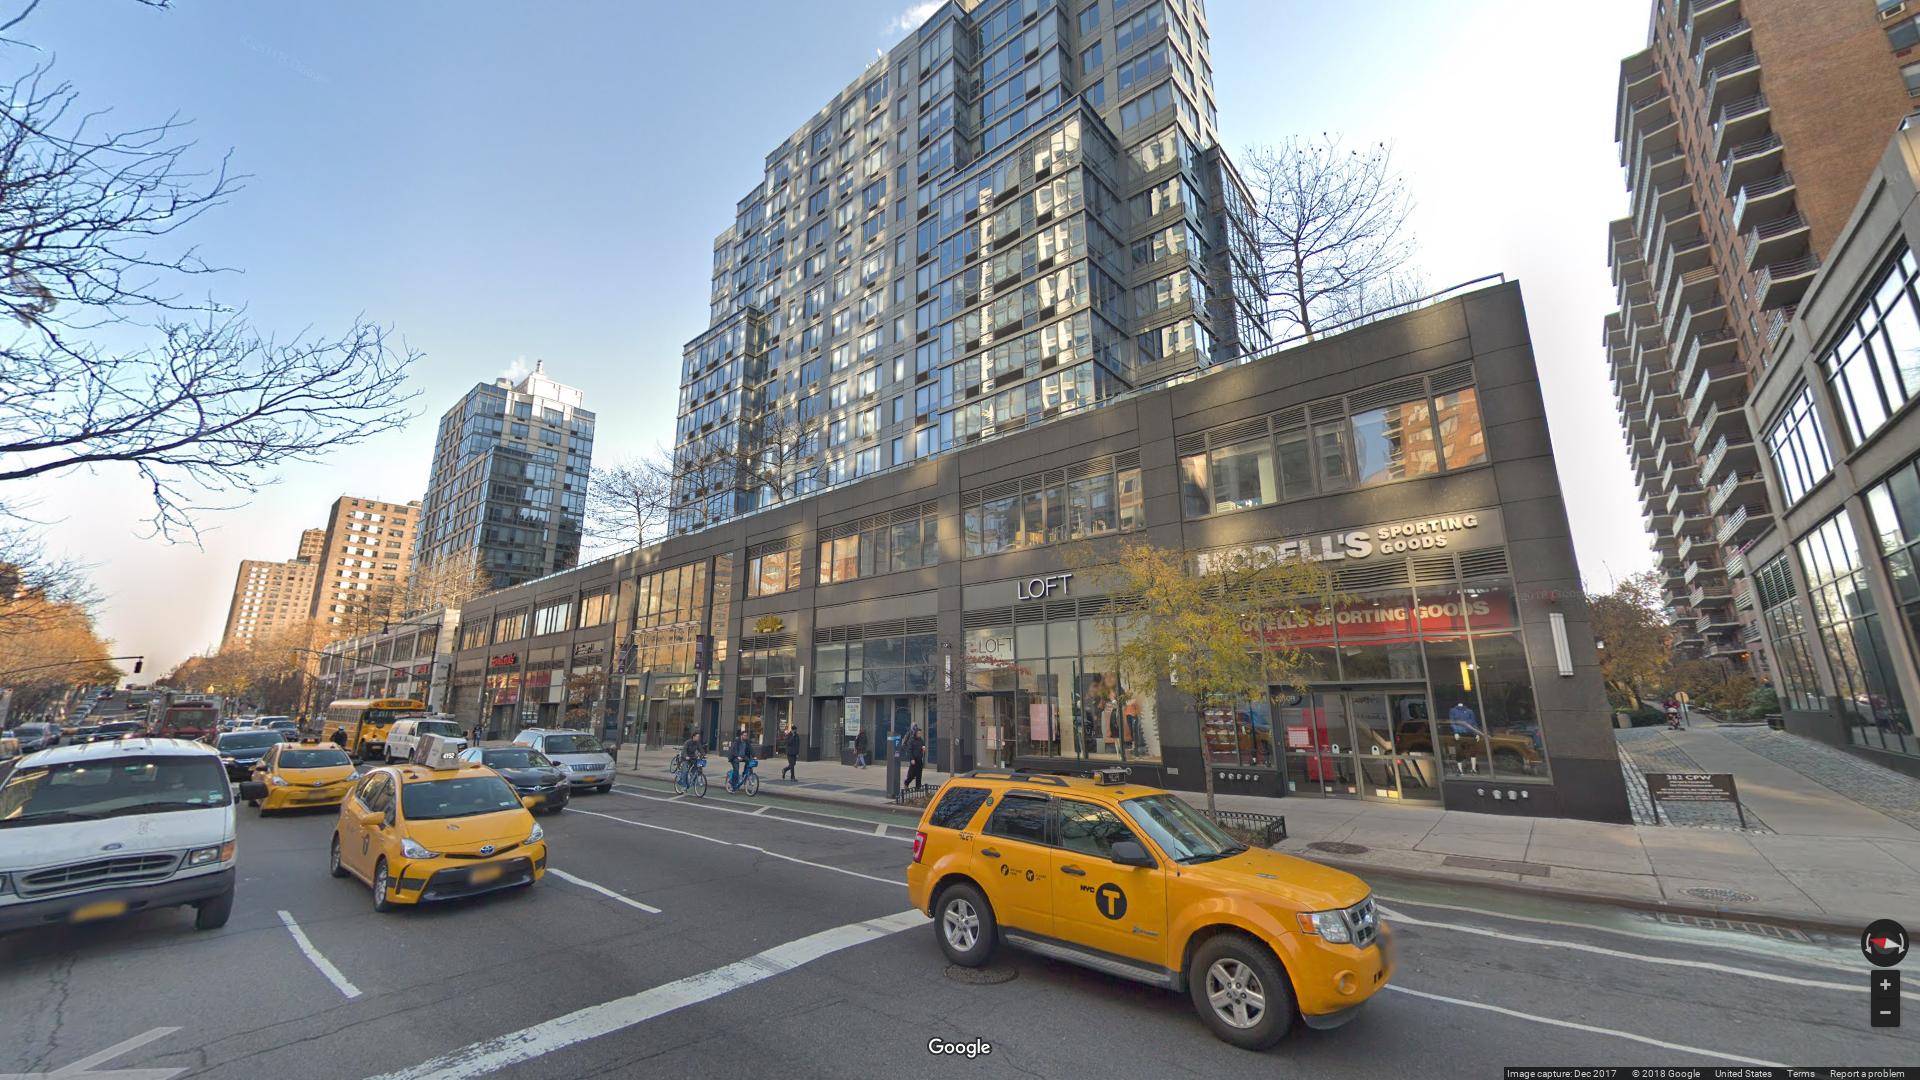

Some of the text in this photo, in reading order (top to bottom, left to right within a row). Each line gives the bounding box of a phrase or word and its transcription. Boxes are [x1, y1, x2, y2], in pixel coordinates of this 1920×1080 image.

[1378, 514, 1478, 541] SPORTING
[1380, 534, 1448, 555] GOODS
[1017, 573, 1073, 600] LOFT
[1314, 607, 1408, 627] SPORTING
[1413, 600, 1490, 619] GOODS
[979, 637, 1014, 653] LOFT
[1080, 884, 1095, 894] NYC
